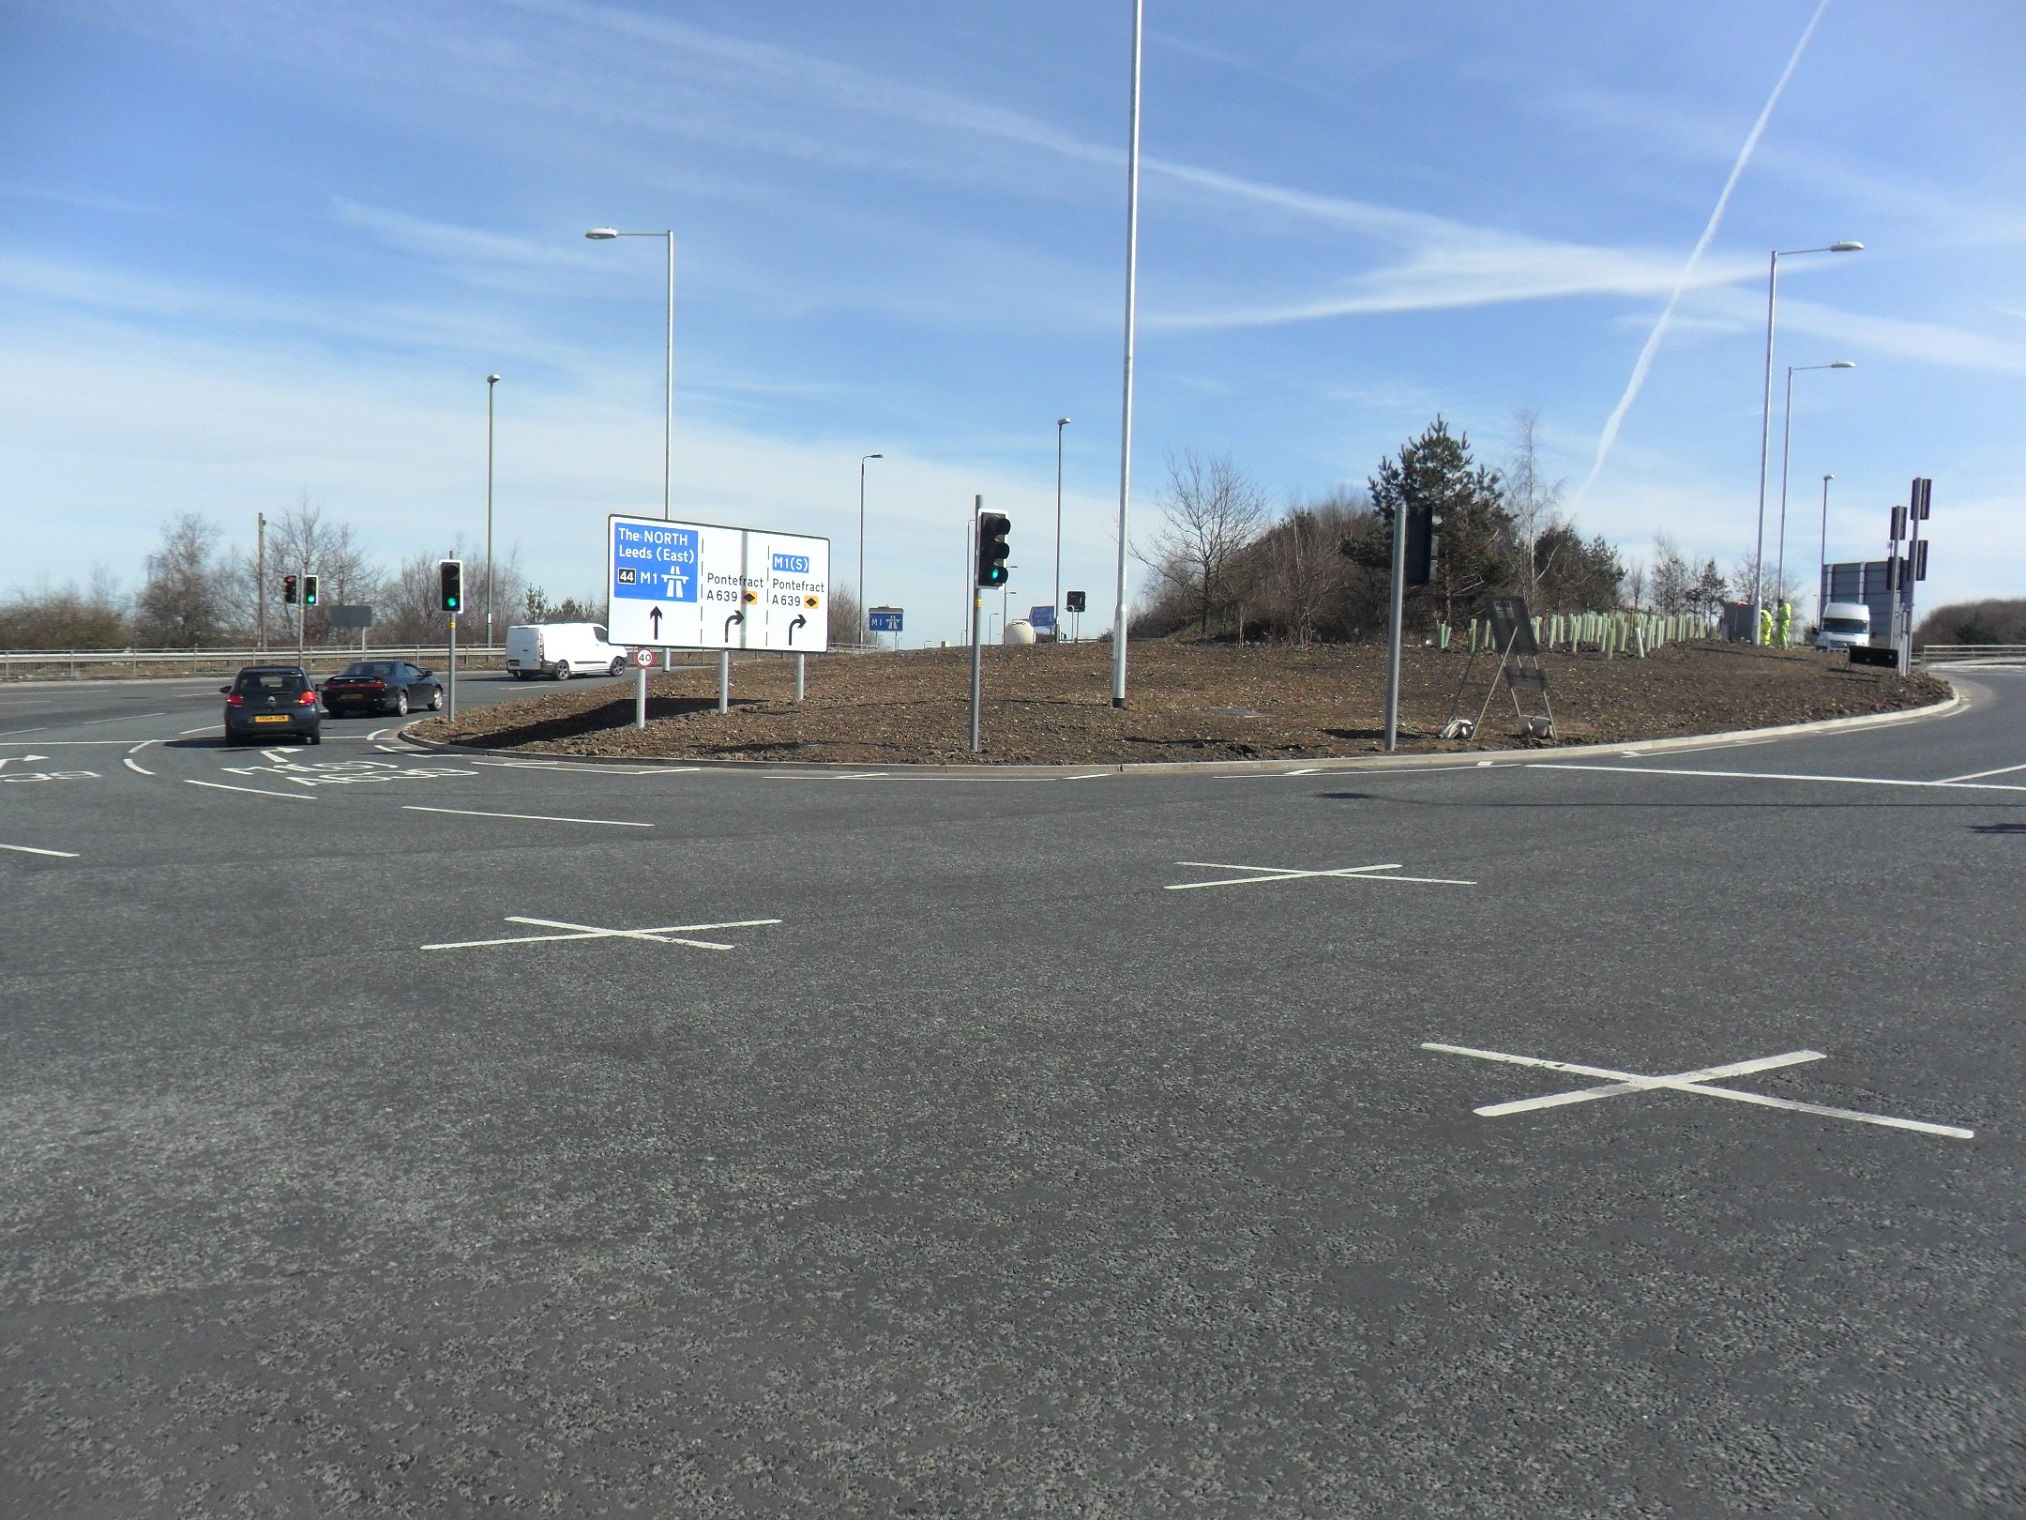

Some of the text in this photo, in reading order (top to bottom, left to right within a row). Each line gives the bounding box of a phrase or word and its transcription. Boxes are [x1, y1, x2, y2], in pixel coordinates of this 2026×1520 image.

[618, 527, 688, 546] The NORTH
[619, 545, 695, 564] Leeds (East)
[774, 556, 809, 572] M1(S)
[620, 570, 658, 584] 44 M1
[707, 572, 764, 588] Pontefract
[772, 578, 825, 593] Pontefract
[706, 590, 738, 602] A639
[772, 595, 801, 606] A639
[871, 618, 882, 626] M1
[638, 654, 652, 662] 40
